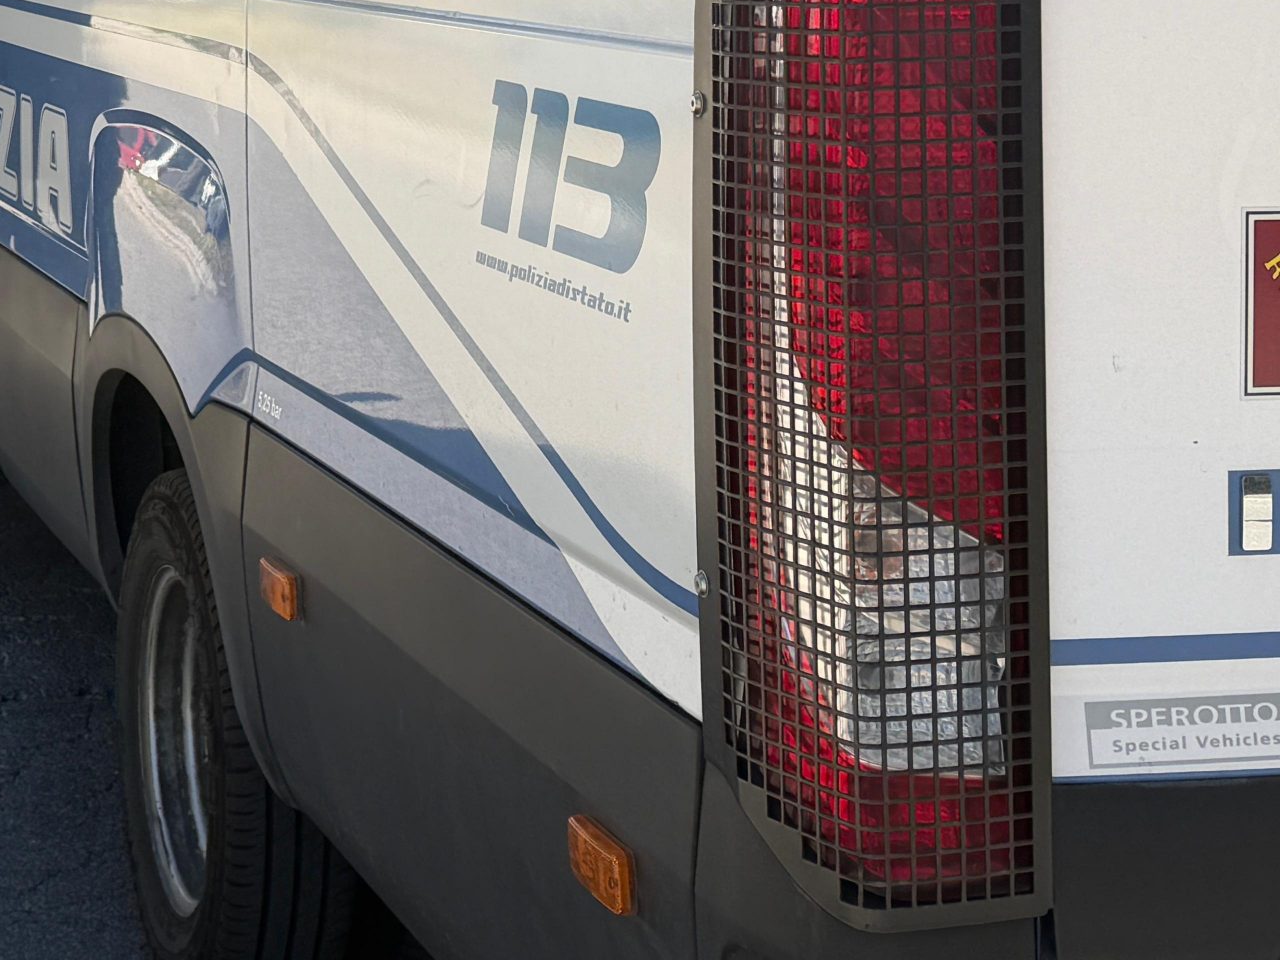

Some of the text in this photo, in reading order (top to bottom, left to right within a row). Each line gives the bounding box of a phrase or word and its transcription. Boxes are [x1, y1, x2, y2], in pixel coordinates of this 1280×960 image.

[480, 79, 662, 275] 113
[475, 250, 633, 324] www.poliziadistato.it
[271, 398, 282, 419] bar
[1109, 702, 1279, 730] SPEROTTO
[1112, 732, 1280, 756] Special Vehicles
